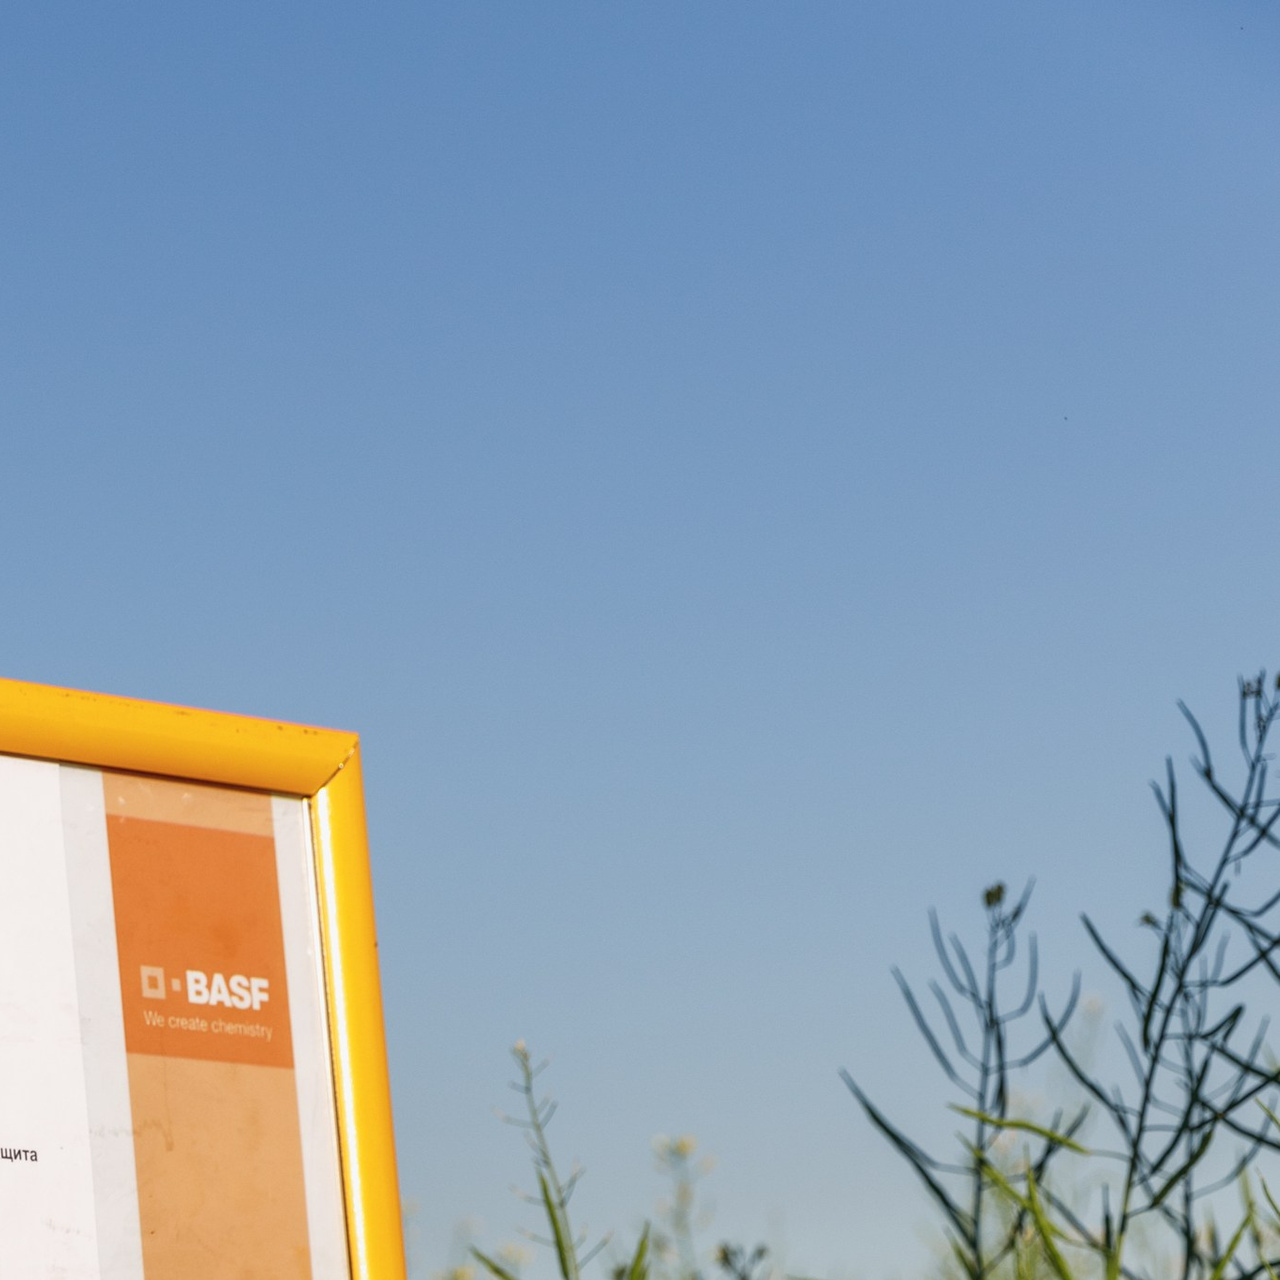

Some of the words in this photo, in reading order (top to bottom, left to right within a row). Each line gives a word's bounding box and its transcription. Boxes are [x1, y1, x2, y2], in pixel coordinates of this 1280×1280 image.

[185, 970, 270, 1010] BASF
[143, 1010, 165, 1027] We
[168, 1015, 208, 1033] create
[211, 1018, 273, 1043] chemistry
